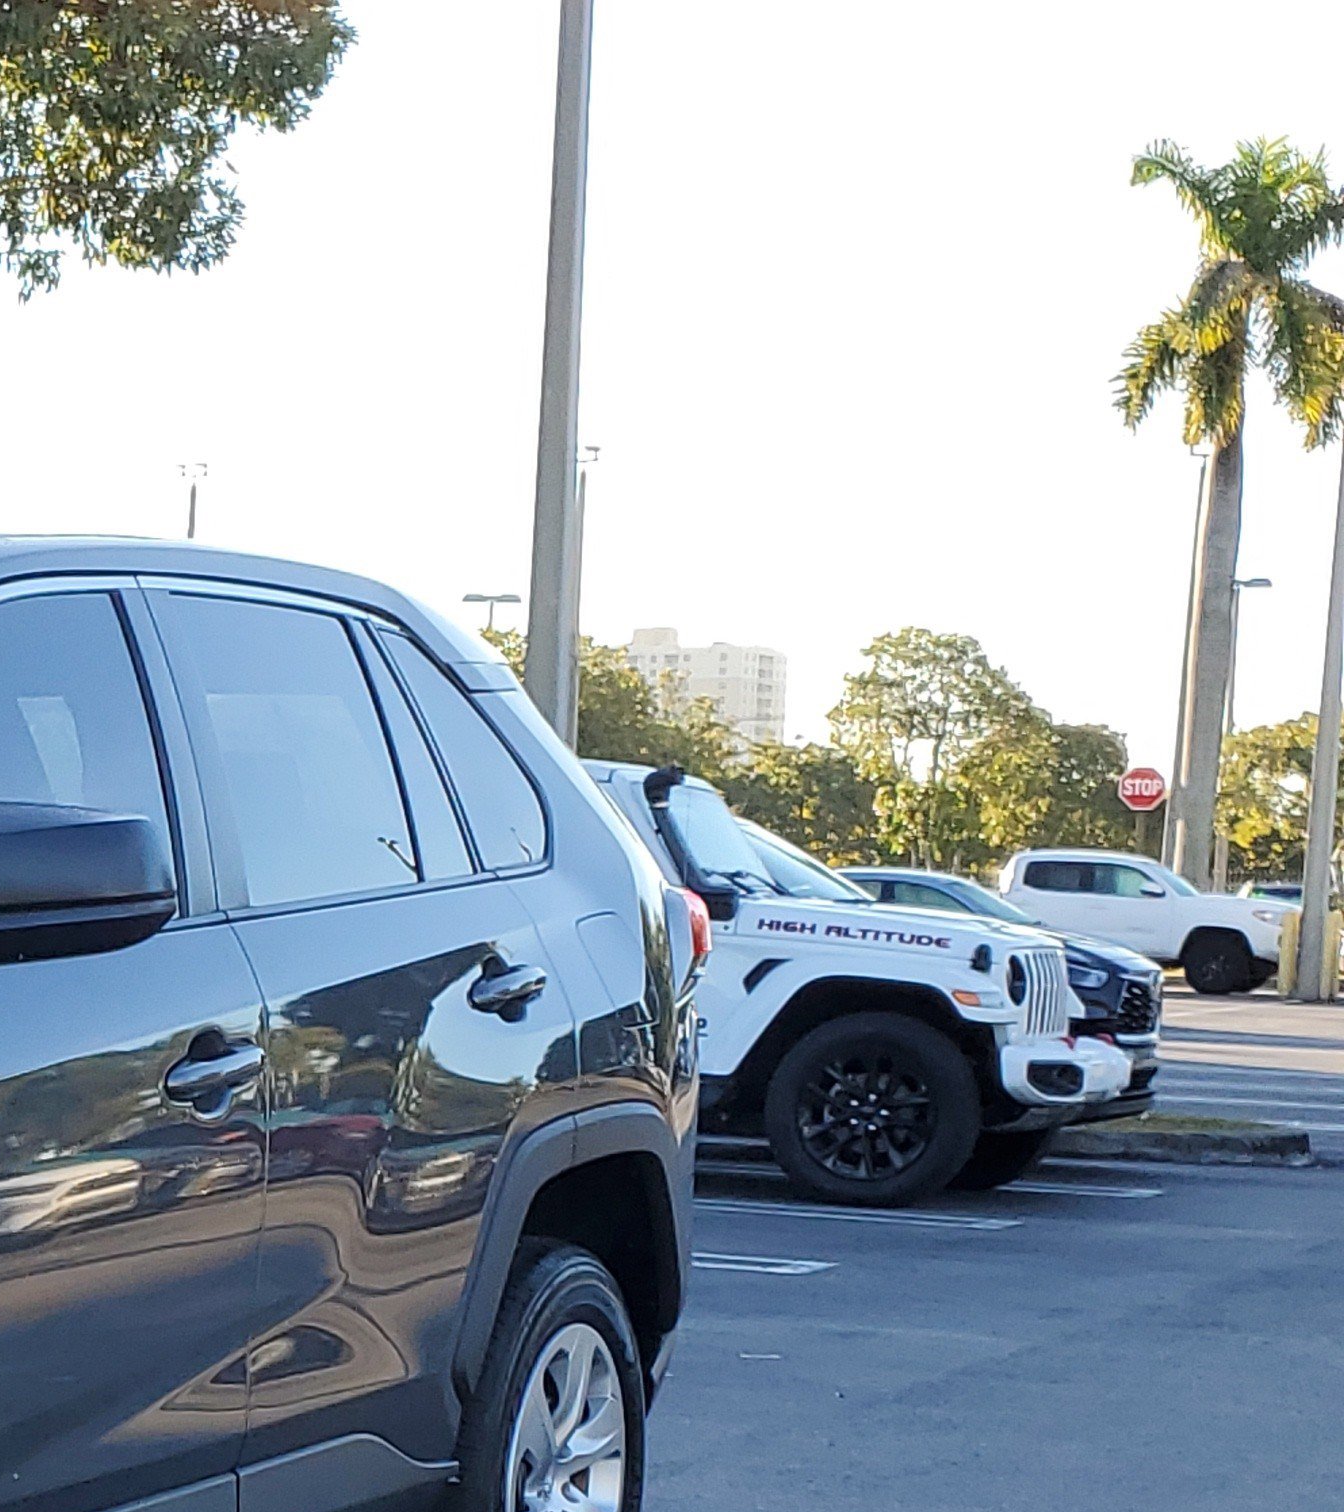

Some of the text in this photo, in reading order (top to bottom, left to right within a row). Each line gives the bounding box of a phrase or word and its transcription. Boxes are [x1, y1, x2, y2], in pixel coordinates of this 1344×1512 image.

[1122, 777, 1164, 797] STOP
[756, 917, 953, 949] HIGH ALTITUDE
